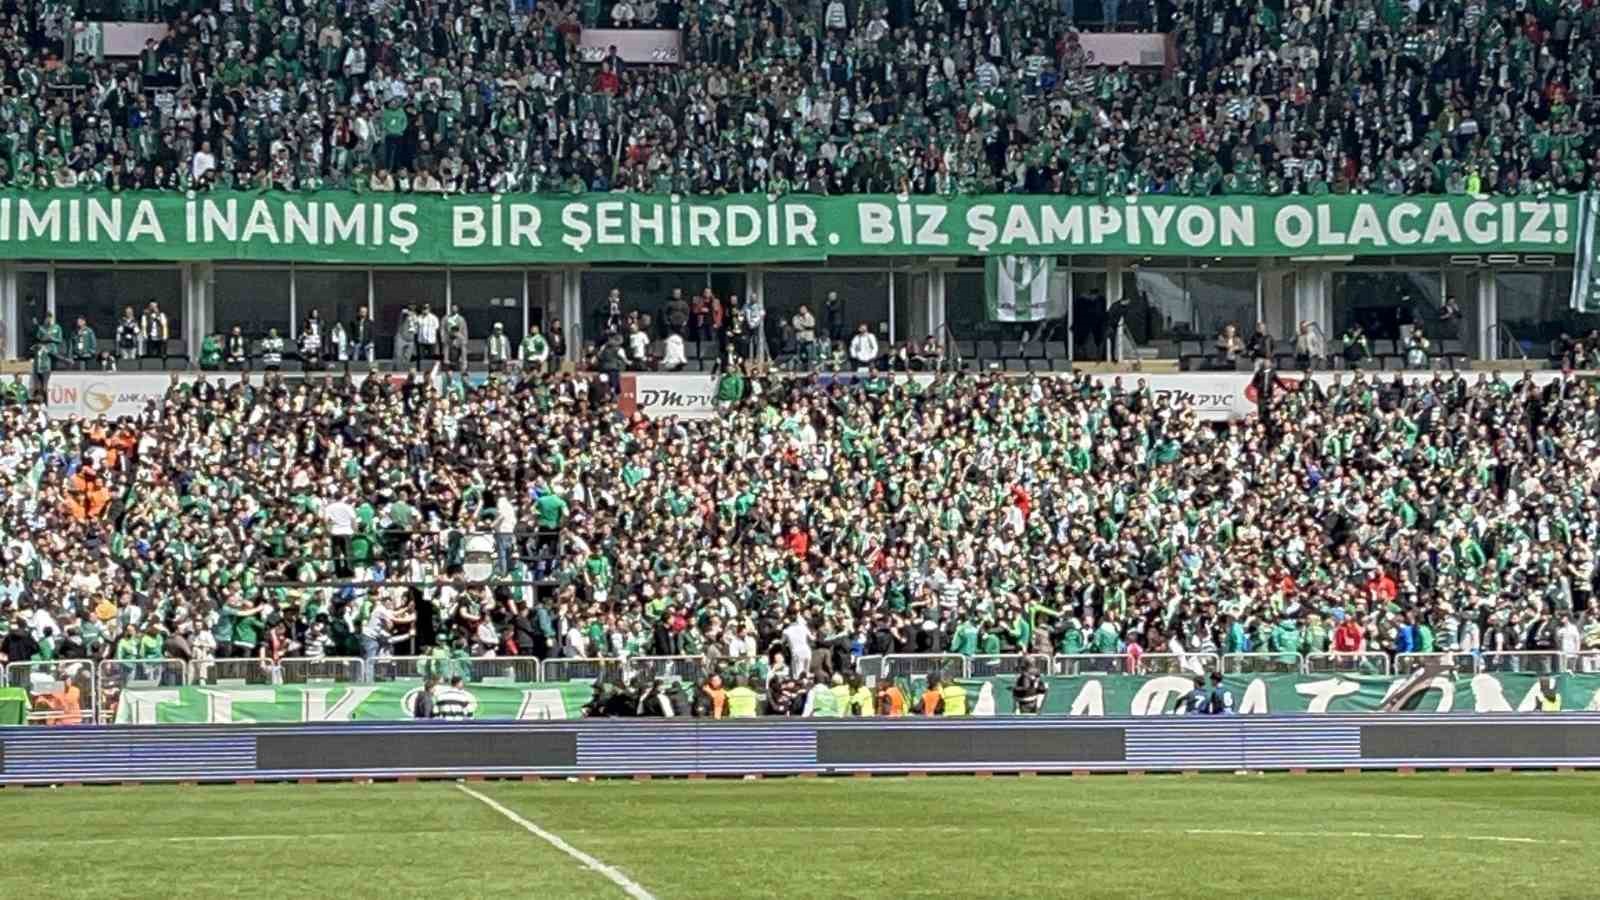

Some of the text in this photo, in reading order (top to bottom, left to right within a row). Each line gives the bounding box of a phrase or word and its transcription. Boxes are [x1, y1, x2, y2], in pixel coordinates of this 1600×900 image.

[185, 190, 419, 254] İNANMIŞ
[452, 194, 542, 248] BİR
[857, 193, 949, 246] BİZ
[966, 194, 1255, 252] ŞAMPİYON
[1199, 393, 1233, 407] PVC
